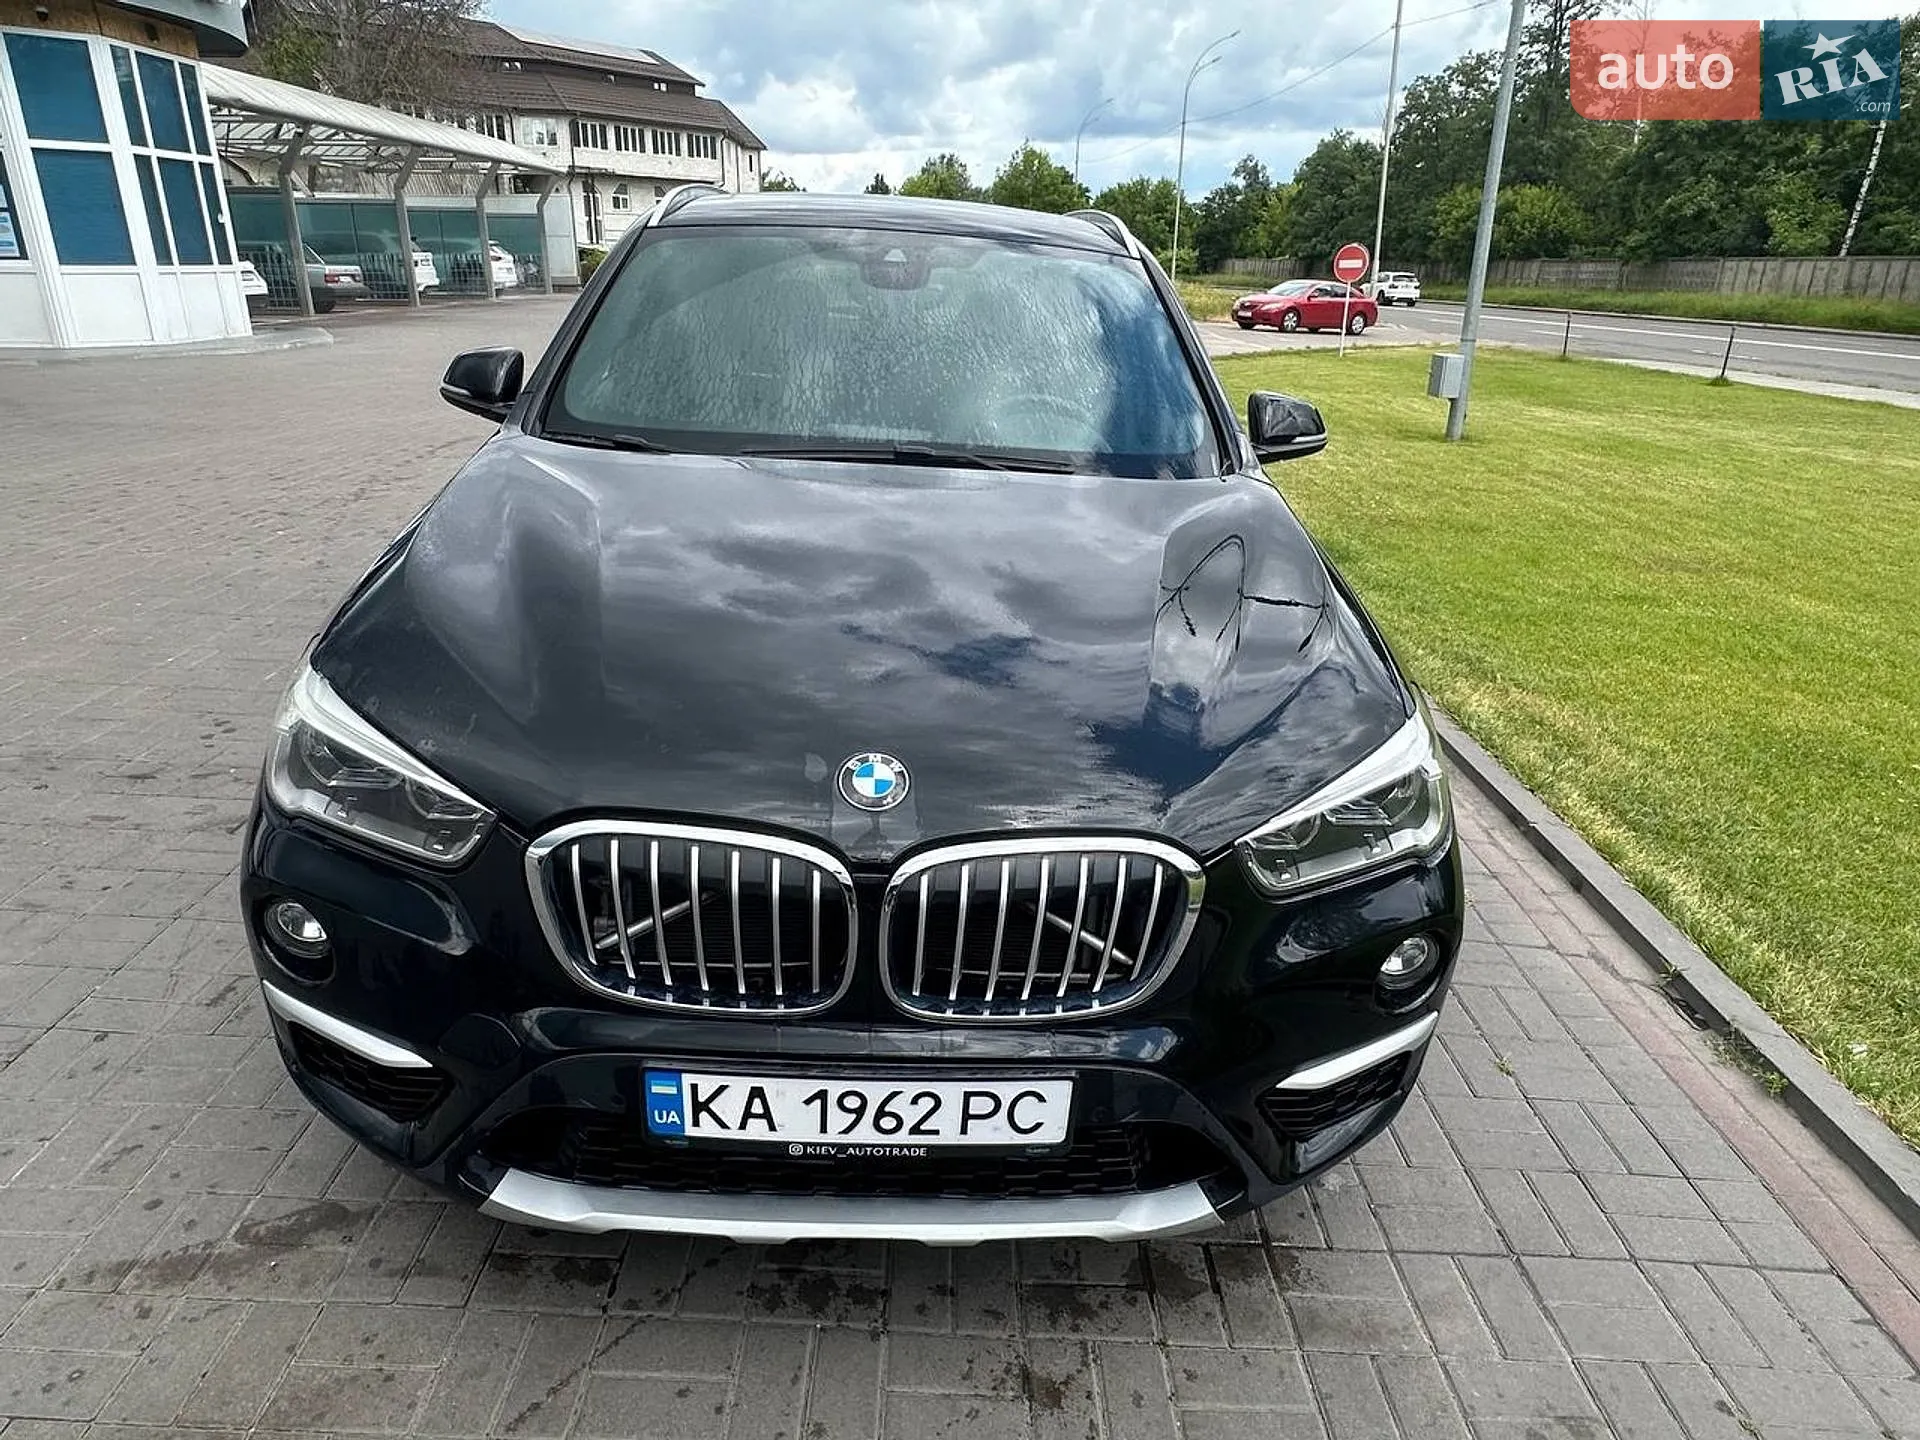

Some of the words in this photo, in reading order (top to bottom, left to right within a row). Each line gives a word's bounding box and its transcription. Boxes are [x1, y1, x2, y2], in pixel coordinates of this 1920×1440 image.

[654, 1109, 681, 1124] UA
[690, 1083, 777, 1132] KA
[802, 1088, 940, 1136] 1962
[959, 1090, 1047, 1136] PC
[806, 1145, 927, 1157] KIEV_AUTOTRADE
